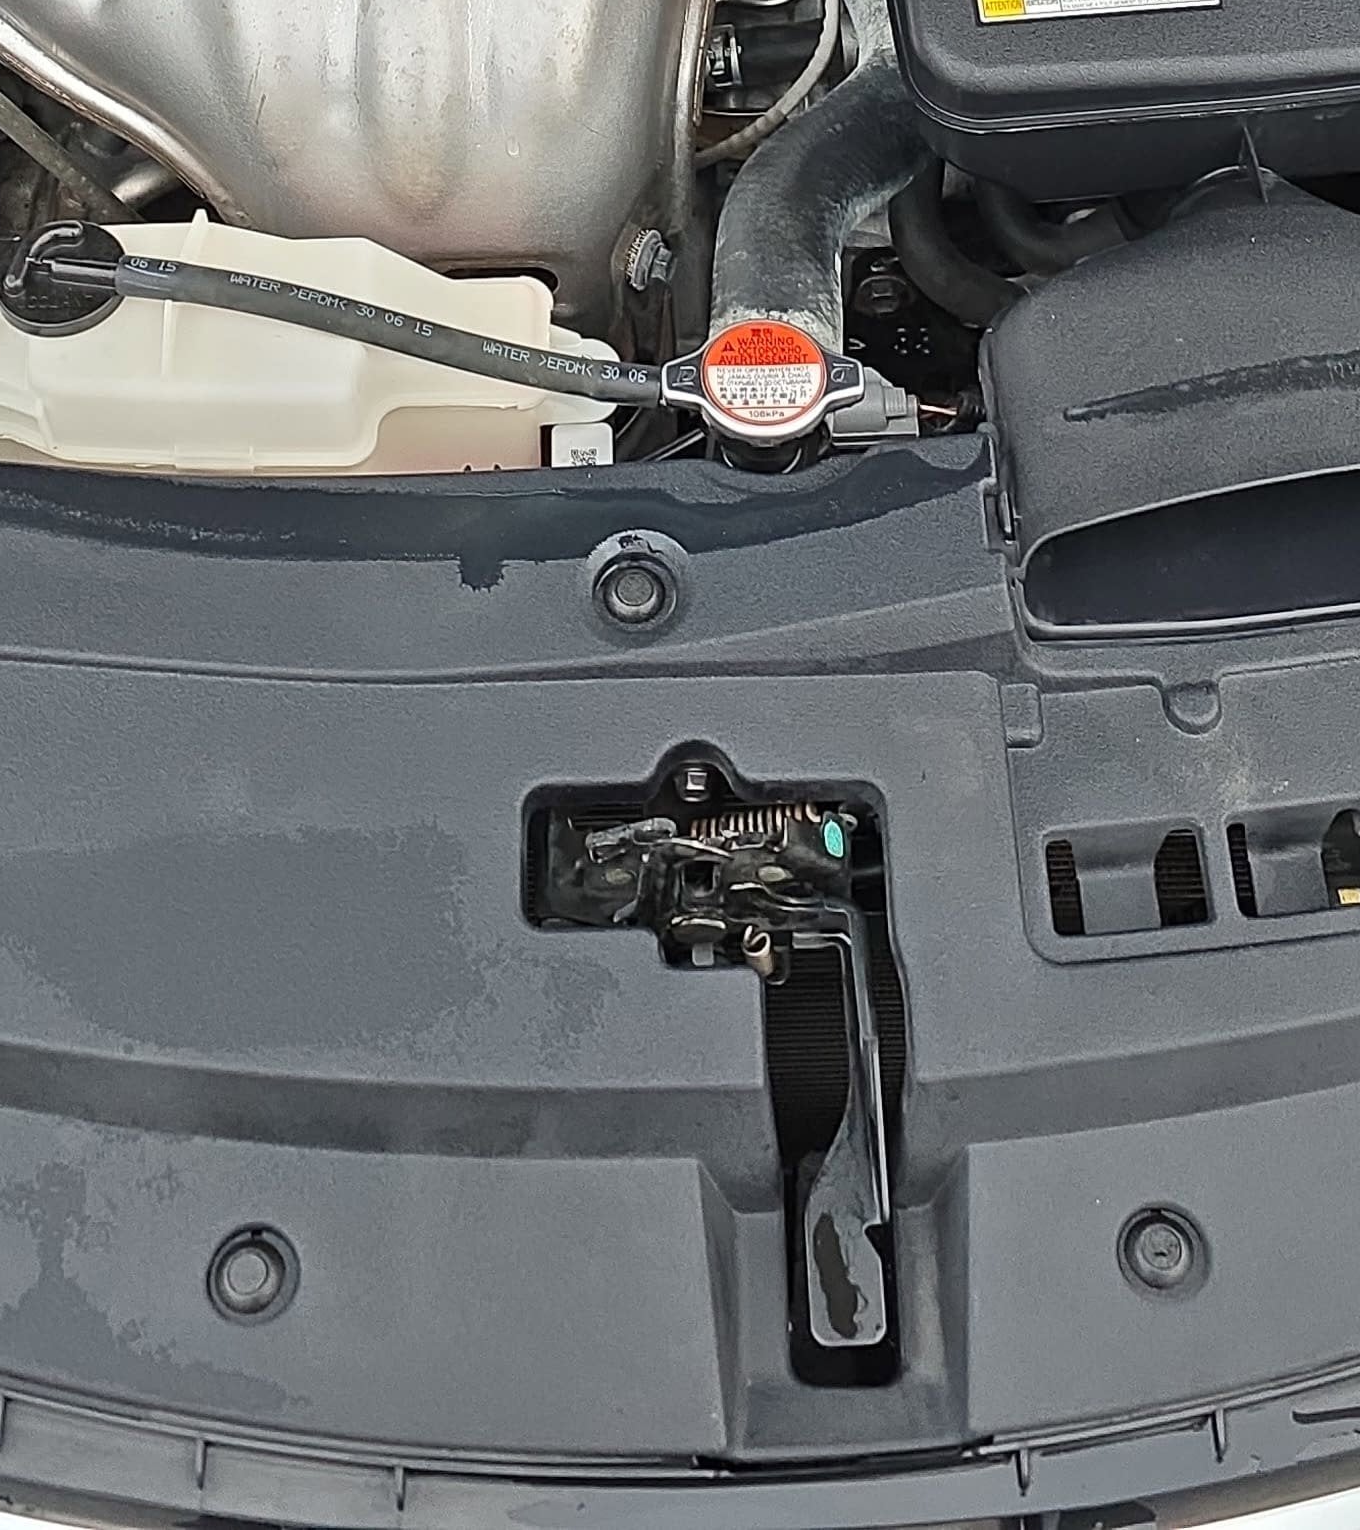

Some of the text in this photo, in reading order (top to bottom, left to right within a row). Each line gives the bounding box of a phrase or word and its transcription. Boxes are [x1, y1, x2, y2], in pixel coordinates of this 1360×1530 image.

[985, 0, 1022, 11] ATTENTION
[129, 257, 177, 272] 06 15
[229, 273, 434, 337] WATER >EPDM< 30 06 15
[737, 336, 794, 346] WARNING
[482, 340, 649, 384] WATER >EPDM< 30 06
[718, 353, 808, 365] AVERTISSEMENT
